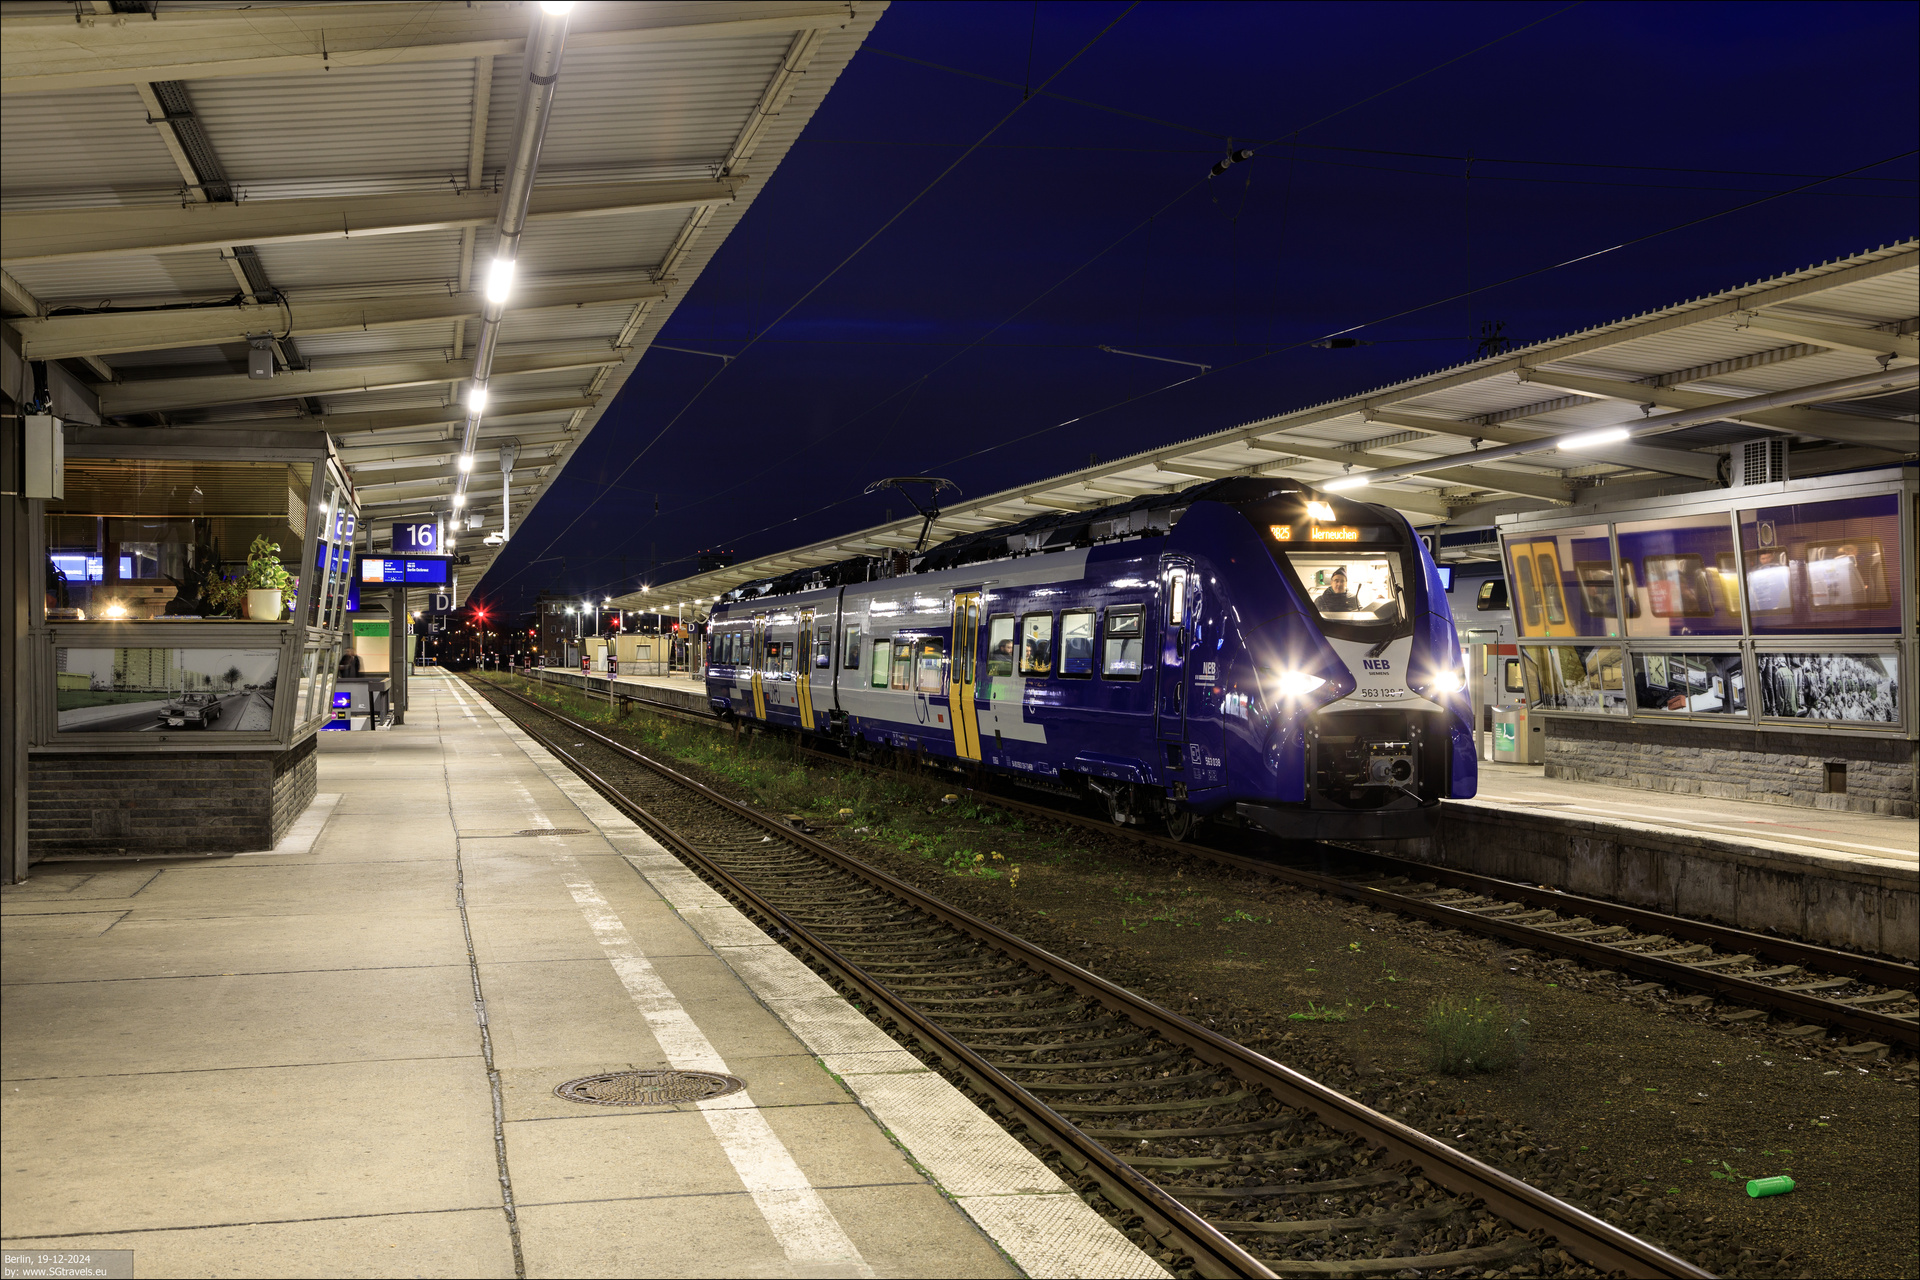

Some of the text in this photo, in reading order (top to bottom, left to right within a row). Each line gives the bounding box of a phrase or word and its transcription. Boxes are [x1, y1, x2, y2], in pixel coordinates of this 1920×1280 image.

[406, 524, 433, 547] 16
[1311, 527, 1357, 540] Werneuchen
[436, 594, 449, 611] D
[688, 623, 695, 632] D
[1499, 624, 1504, 637] 2
[608, 662, 616, 672] H
[1202, 661, 1216, 675] NEB
[1363, 659, 1391, 670] NEB
[1361, 688, 1379, 698] 563
